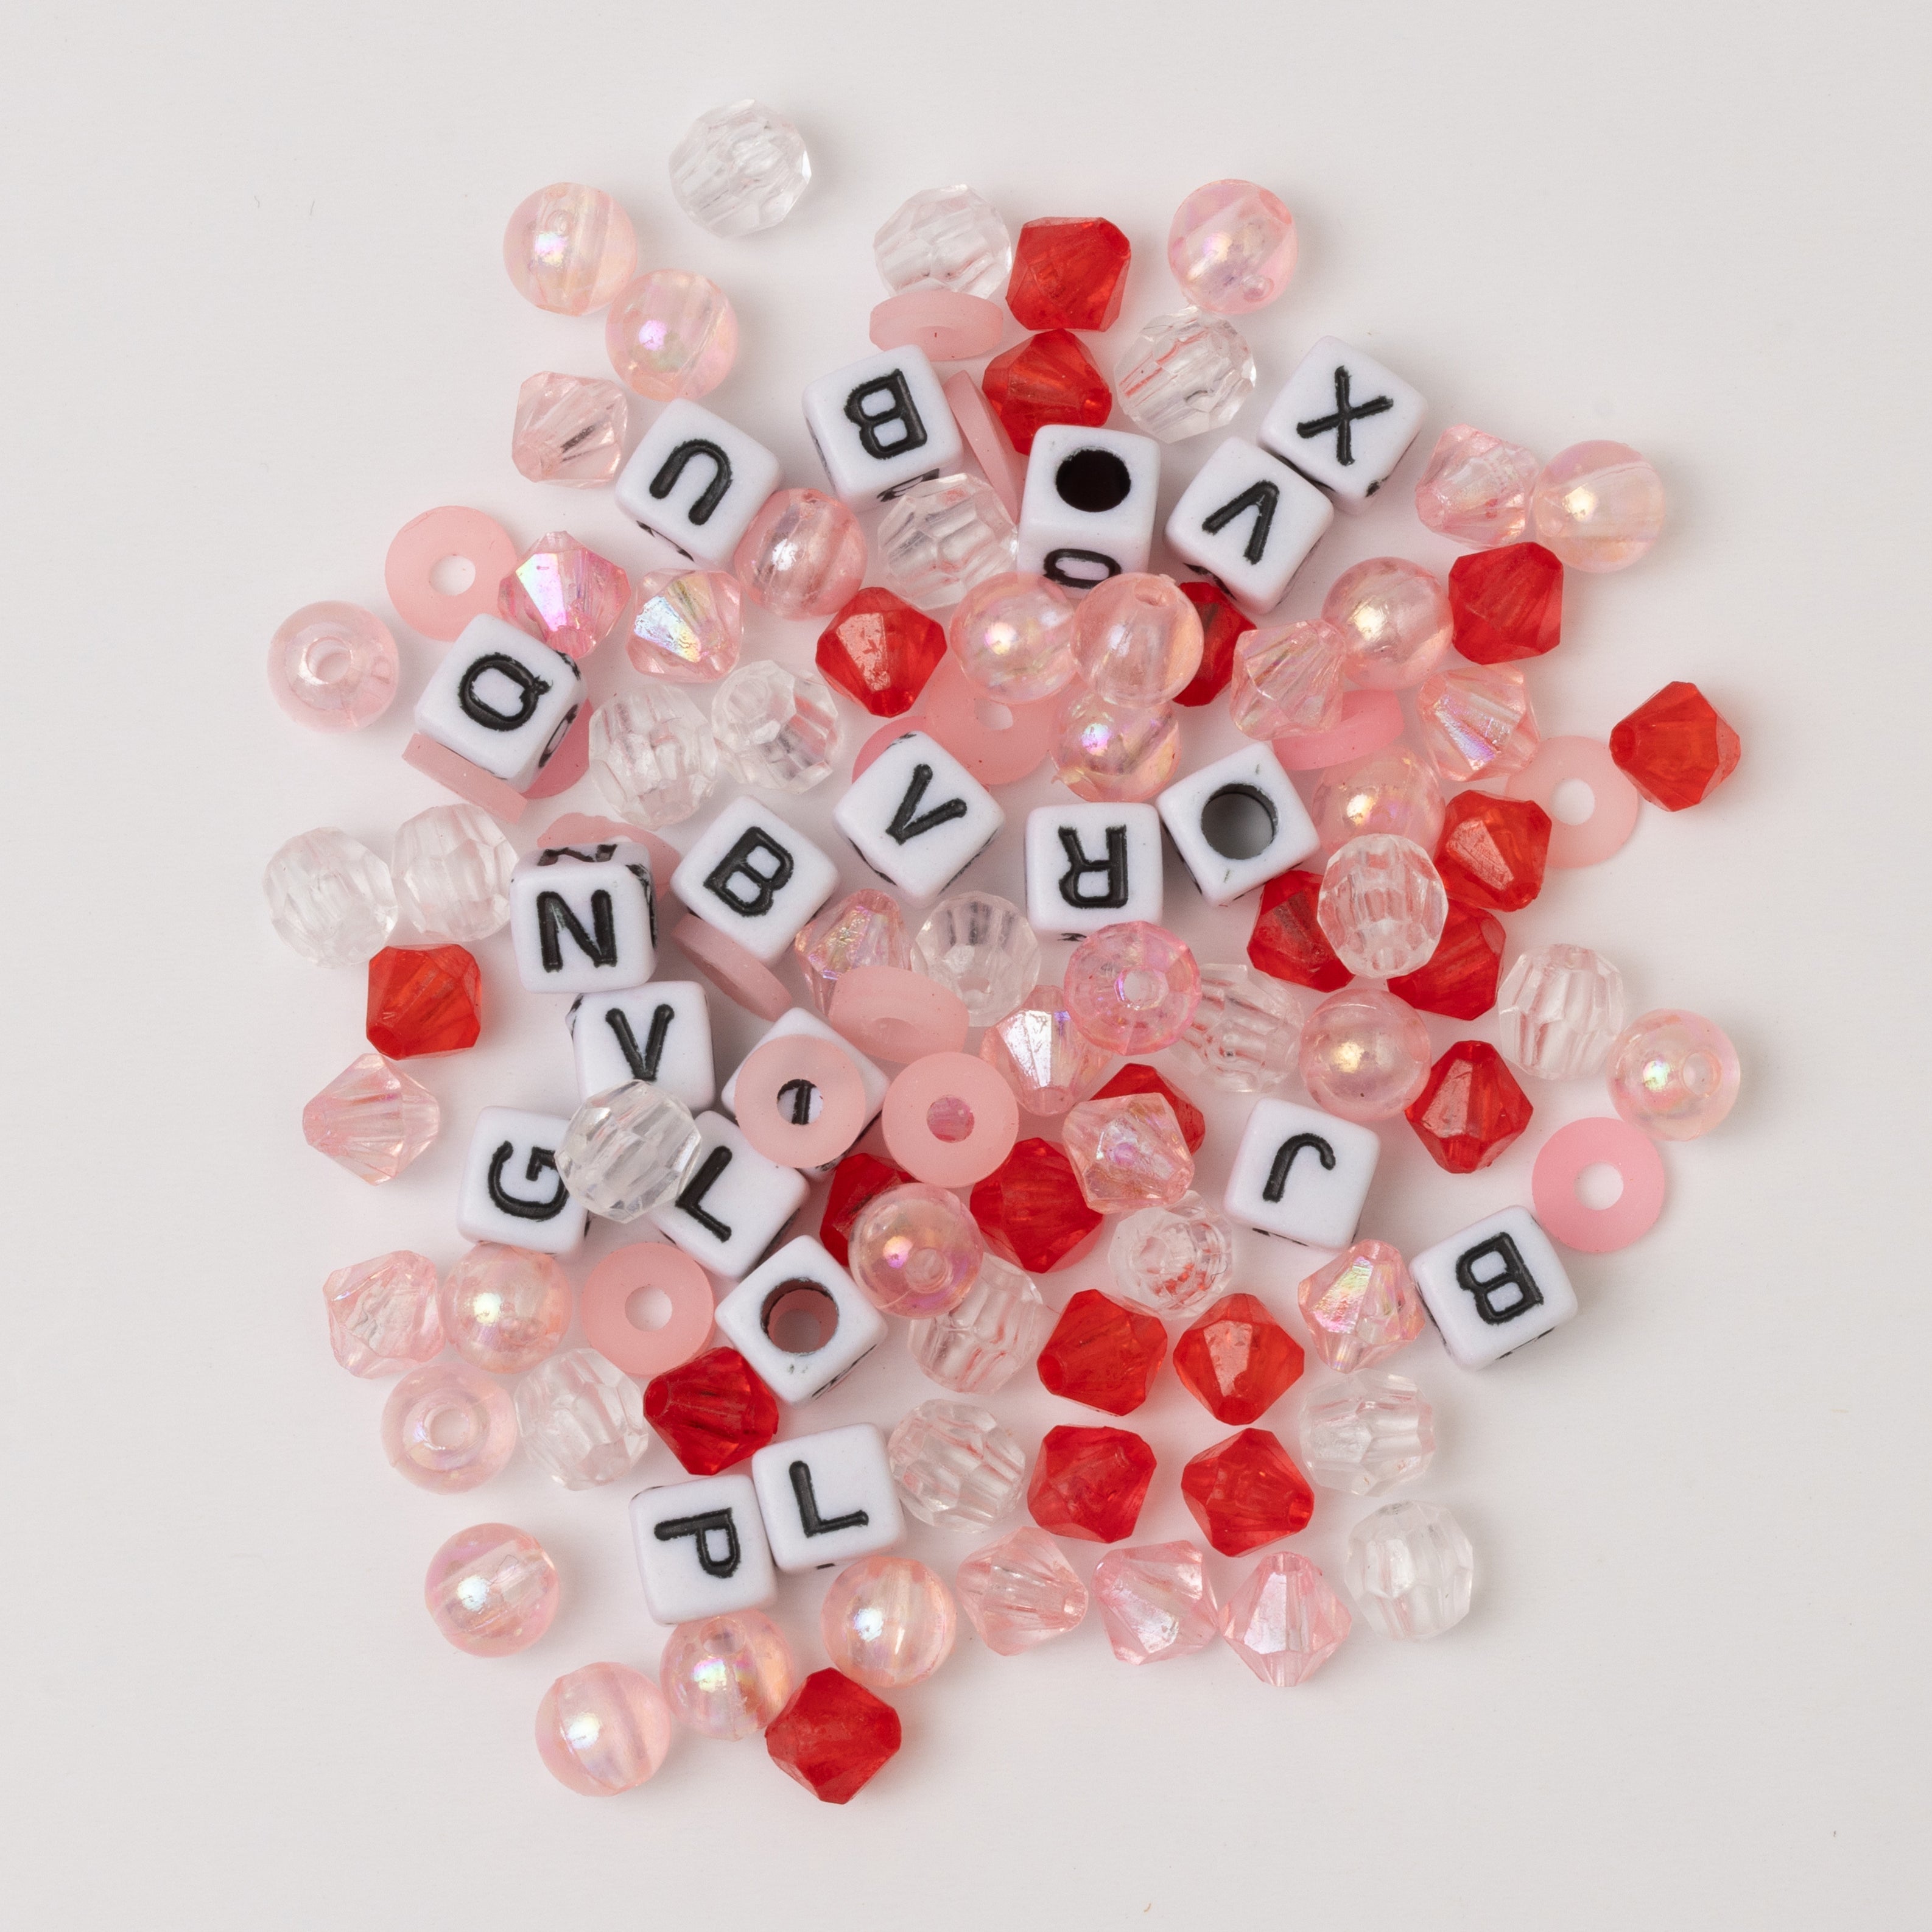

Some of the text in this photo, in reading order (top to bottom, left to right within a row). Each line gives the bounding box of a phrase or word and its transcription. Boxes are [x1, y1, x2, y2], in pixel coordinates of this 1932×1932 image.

[844, 369, 927, 460] B
[1296, 366, 1393, 466] X
[650, 439, 732, 525] U
[1203, 480, 1279, 564] V
[458, 652, 551, 731] Q
[886, 764, 967, 845] V
[703, 827, 793, 917] B
[1058, 824, 1128, 909] R
[536, 890, 617, 972] N
[606, 1004, 674, 1082] V
[488, 1140, 570, 1221] G
[675, 1146, 732, 1242] L
[1263, 1133, 1335, 1203] J
[1456, 1232, 1544, 1325] B
[789, 1461, 868, 1537] L
[654, 1508, 740, 1578] P
